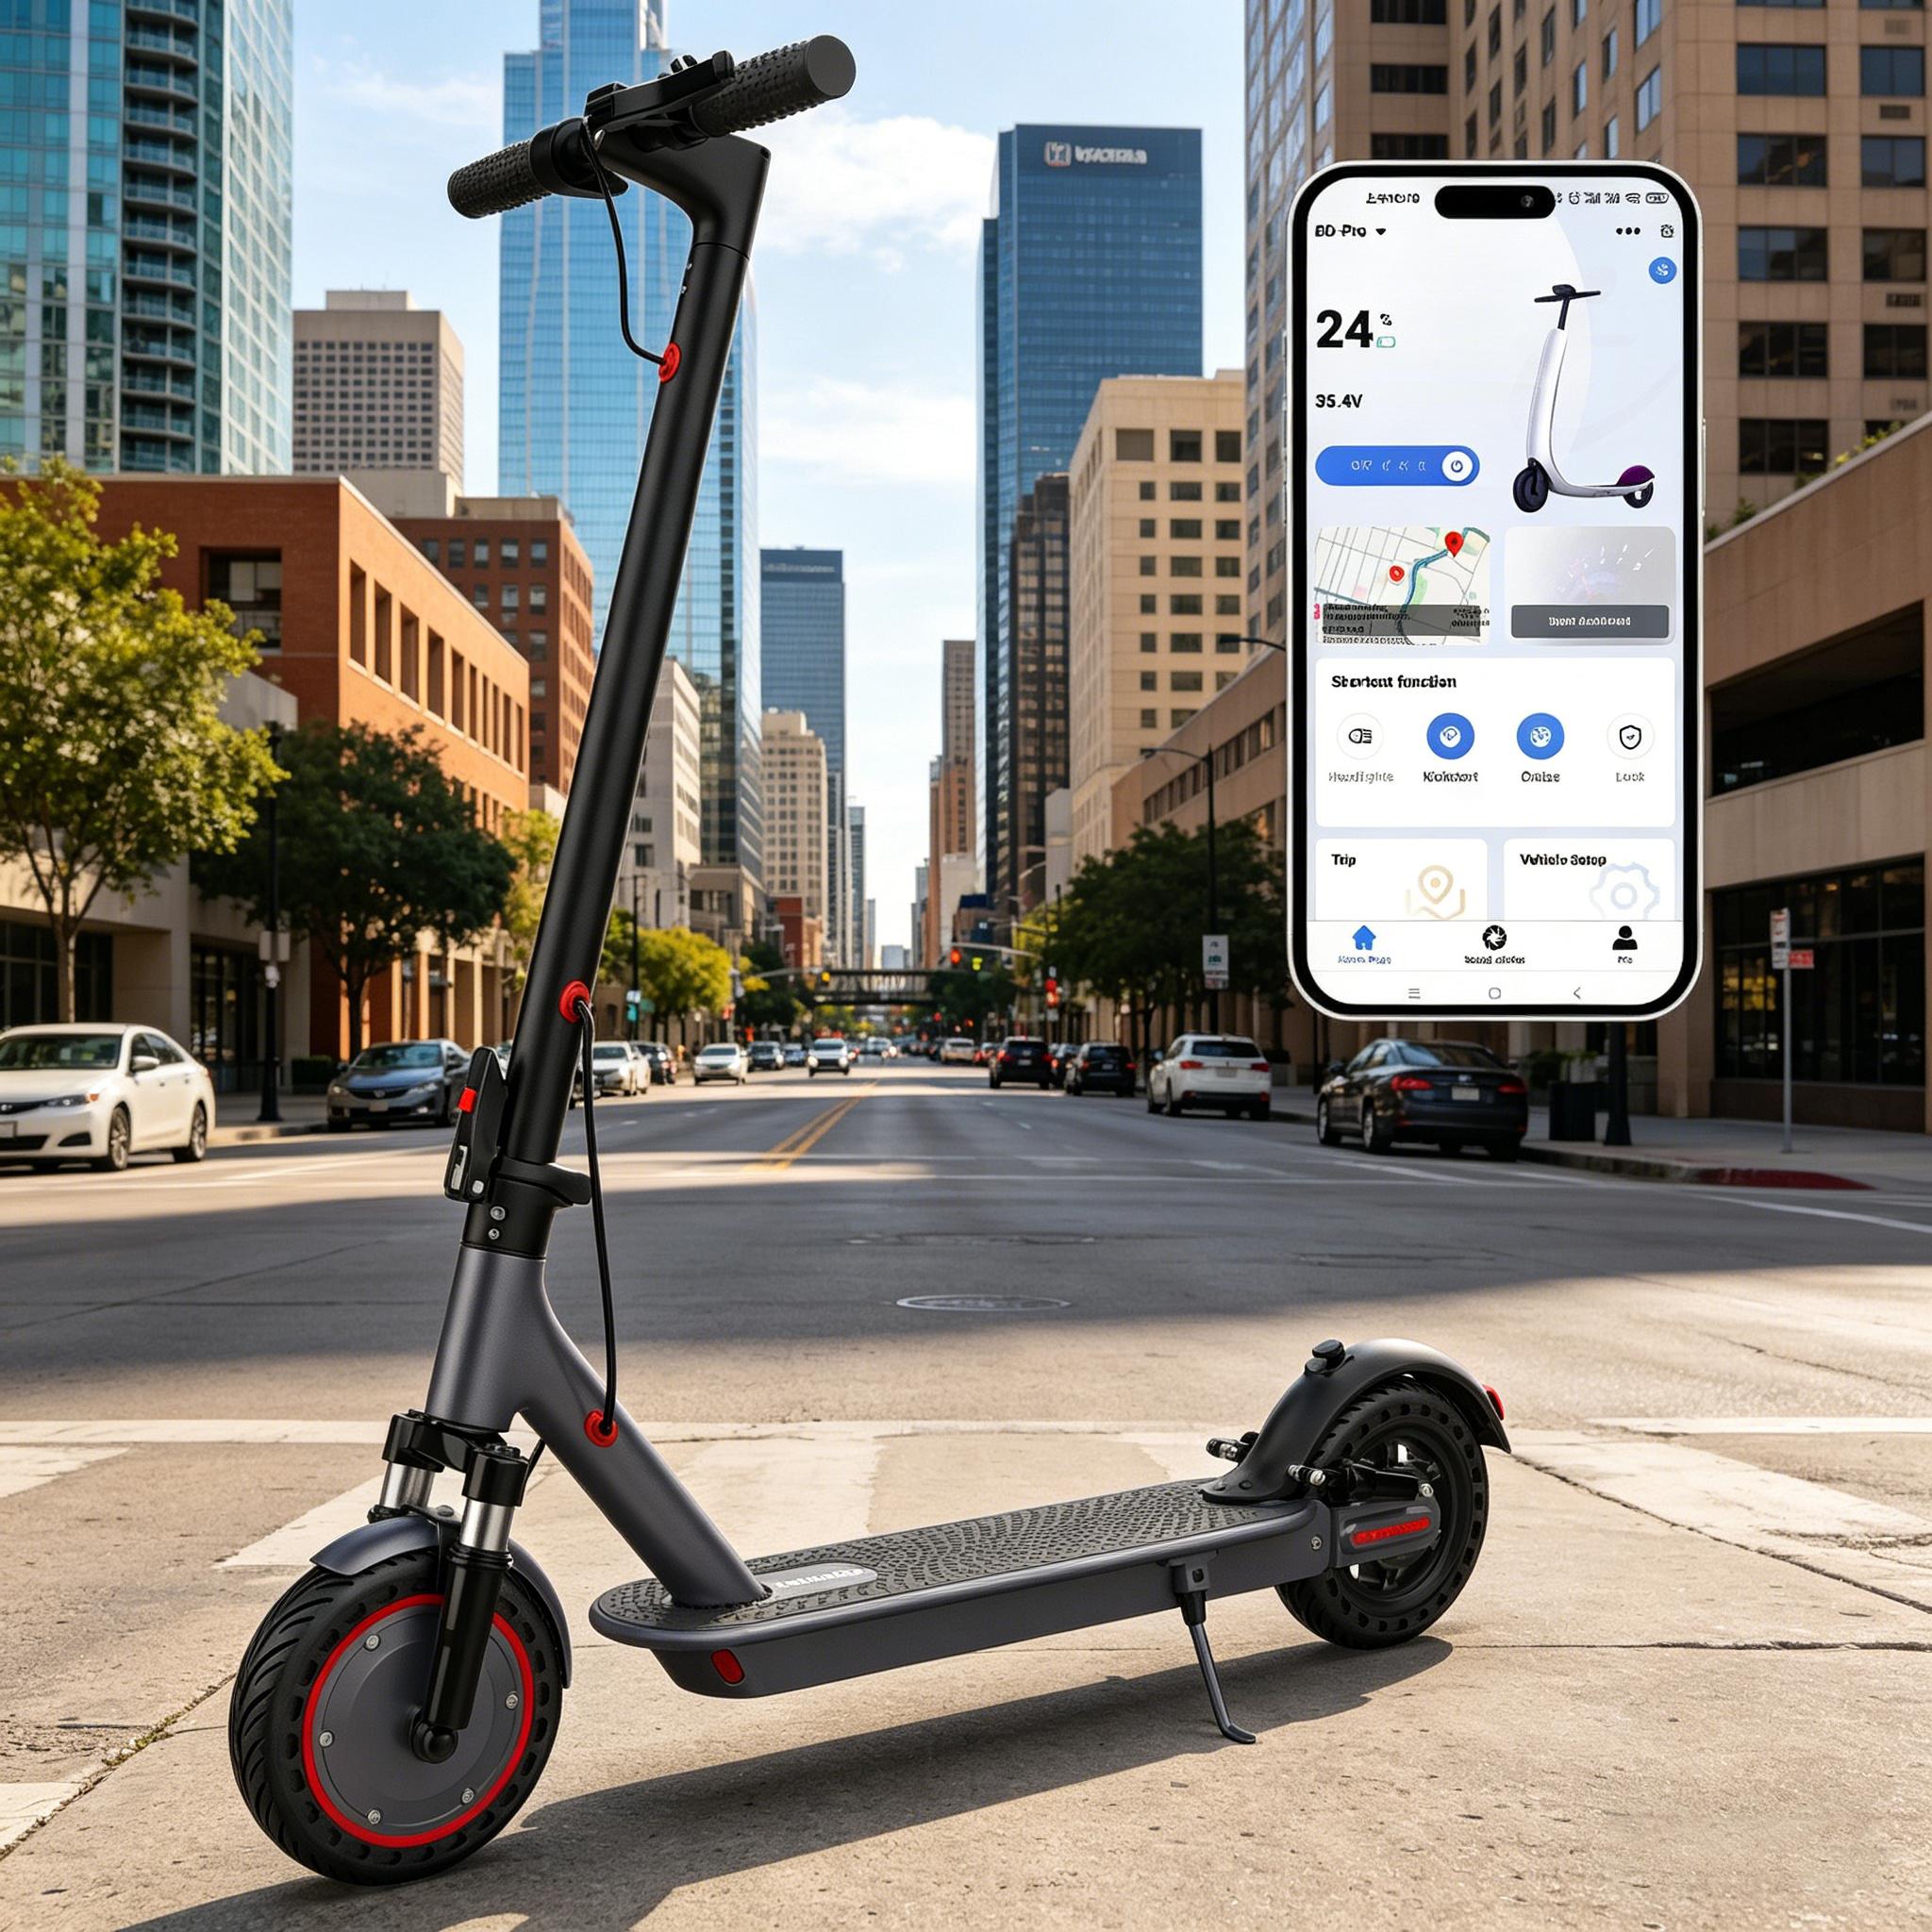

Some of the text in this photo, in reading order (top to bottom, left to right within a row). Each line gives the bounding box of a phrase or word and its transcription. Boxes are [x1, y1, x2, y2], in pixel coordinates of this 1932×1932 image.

[1316, 308, 1374, 349] 24
[1314, 393, 1363, 408] 35.4V
[1331, 853, 1357, 869] Trip
